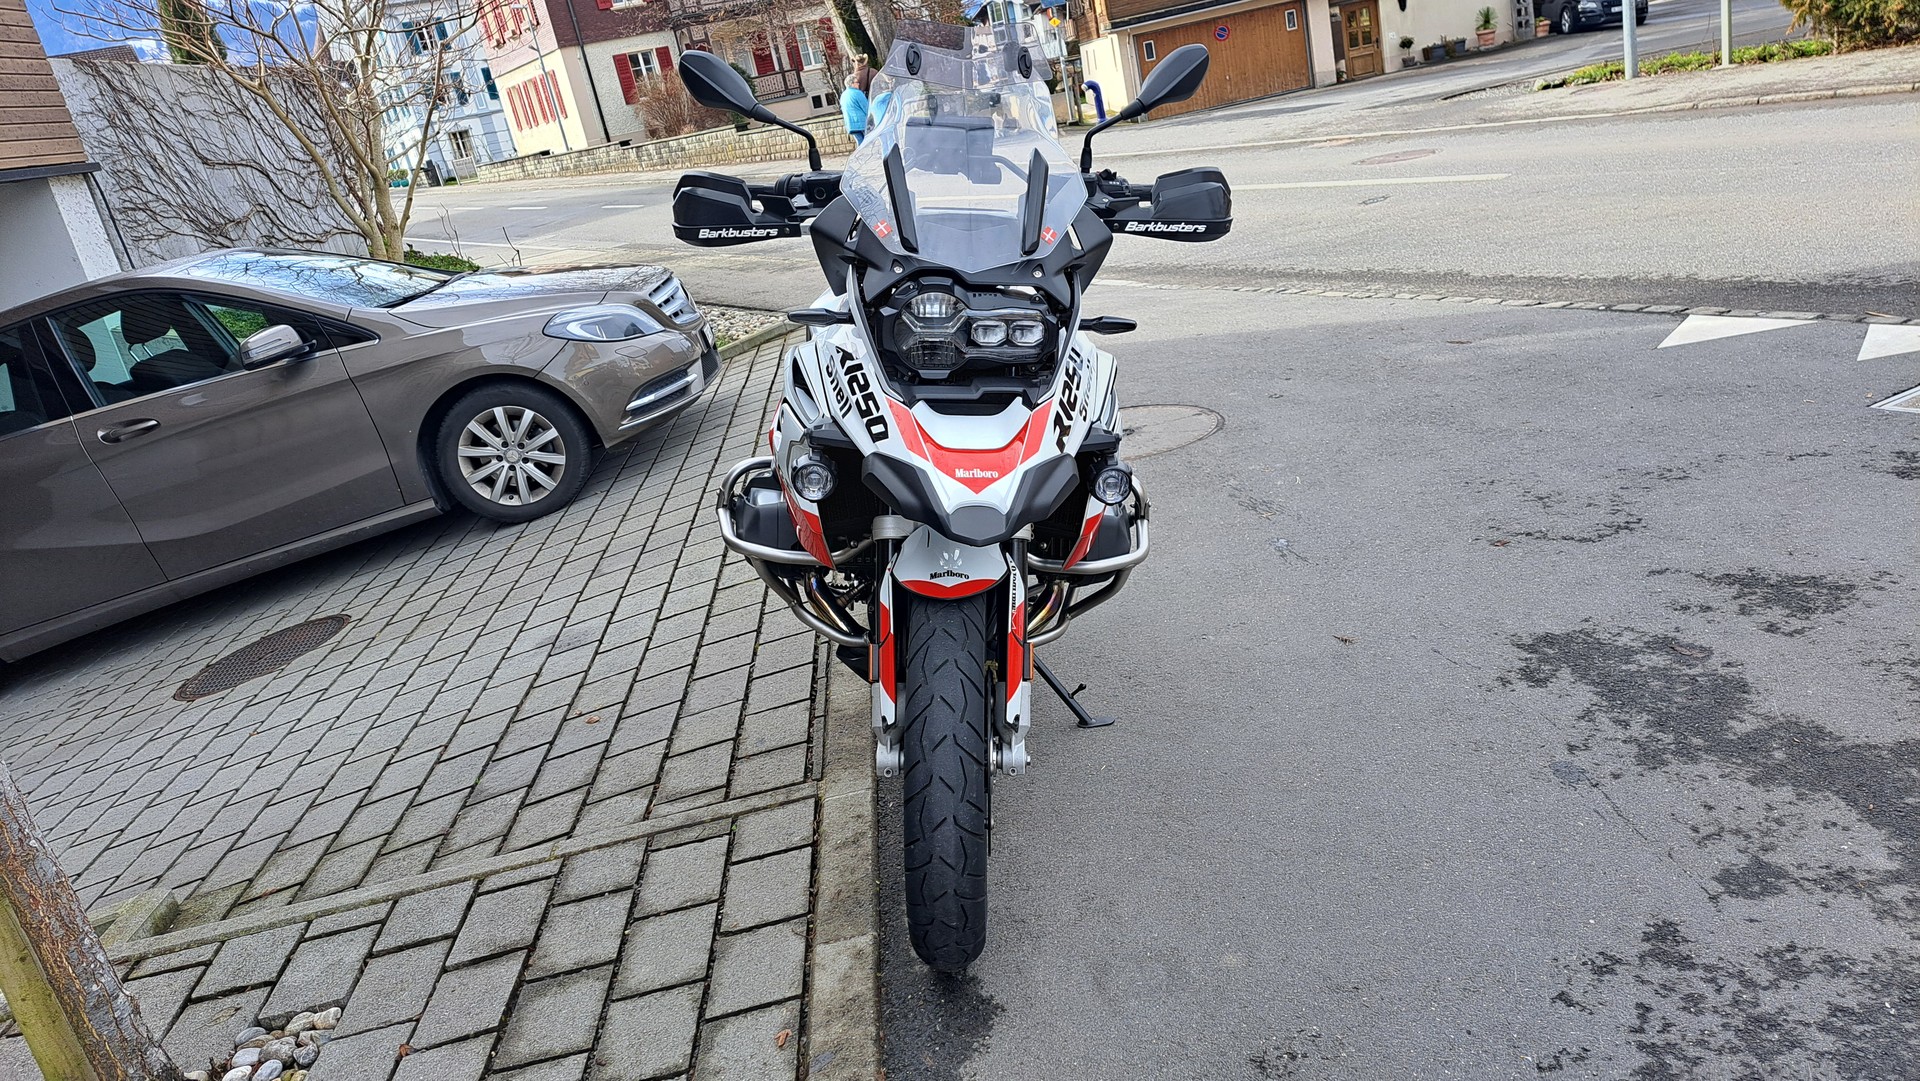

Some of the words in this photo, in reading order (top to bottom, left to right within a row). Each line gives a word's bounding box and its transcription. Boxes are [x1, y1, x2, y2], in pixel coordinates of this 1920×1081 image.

[698, 227, 778, 239] Barkbusters
[1124, 221, 1207, 233] Barkbusters
[826, 354, 853, 419] Shell
[955, 468, 999, 479] Marlboro
[929, 569, 970, 581] Marlboro
